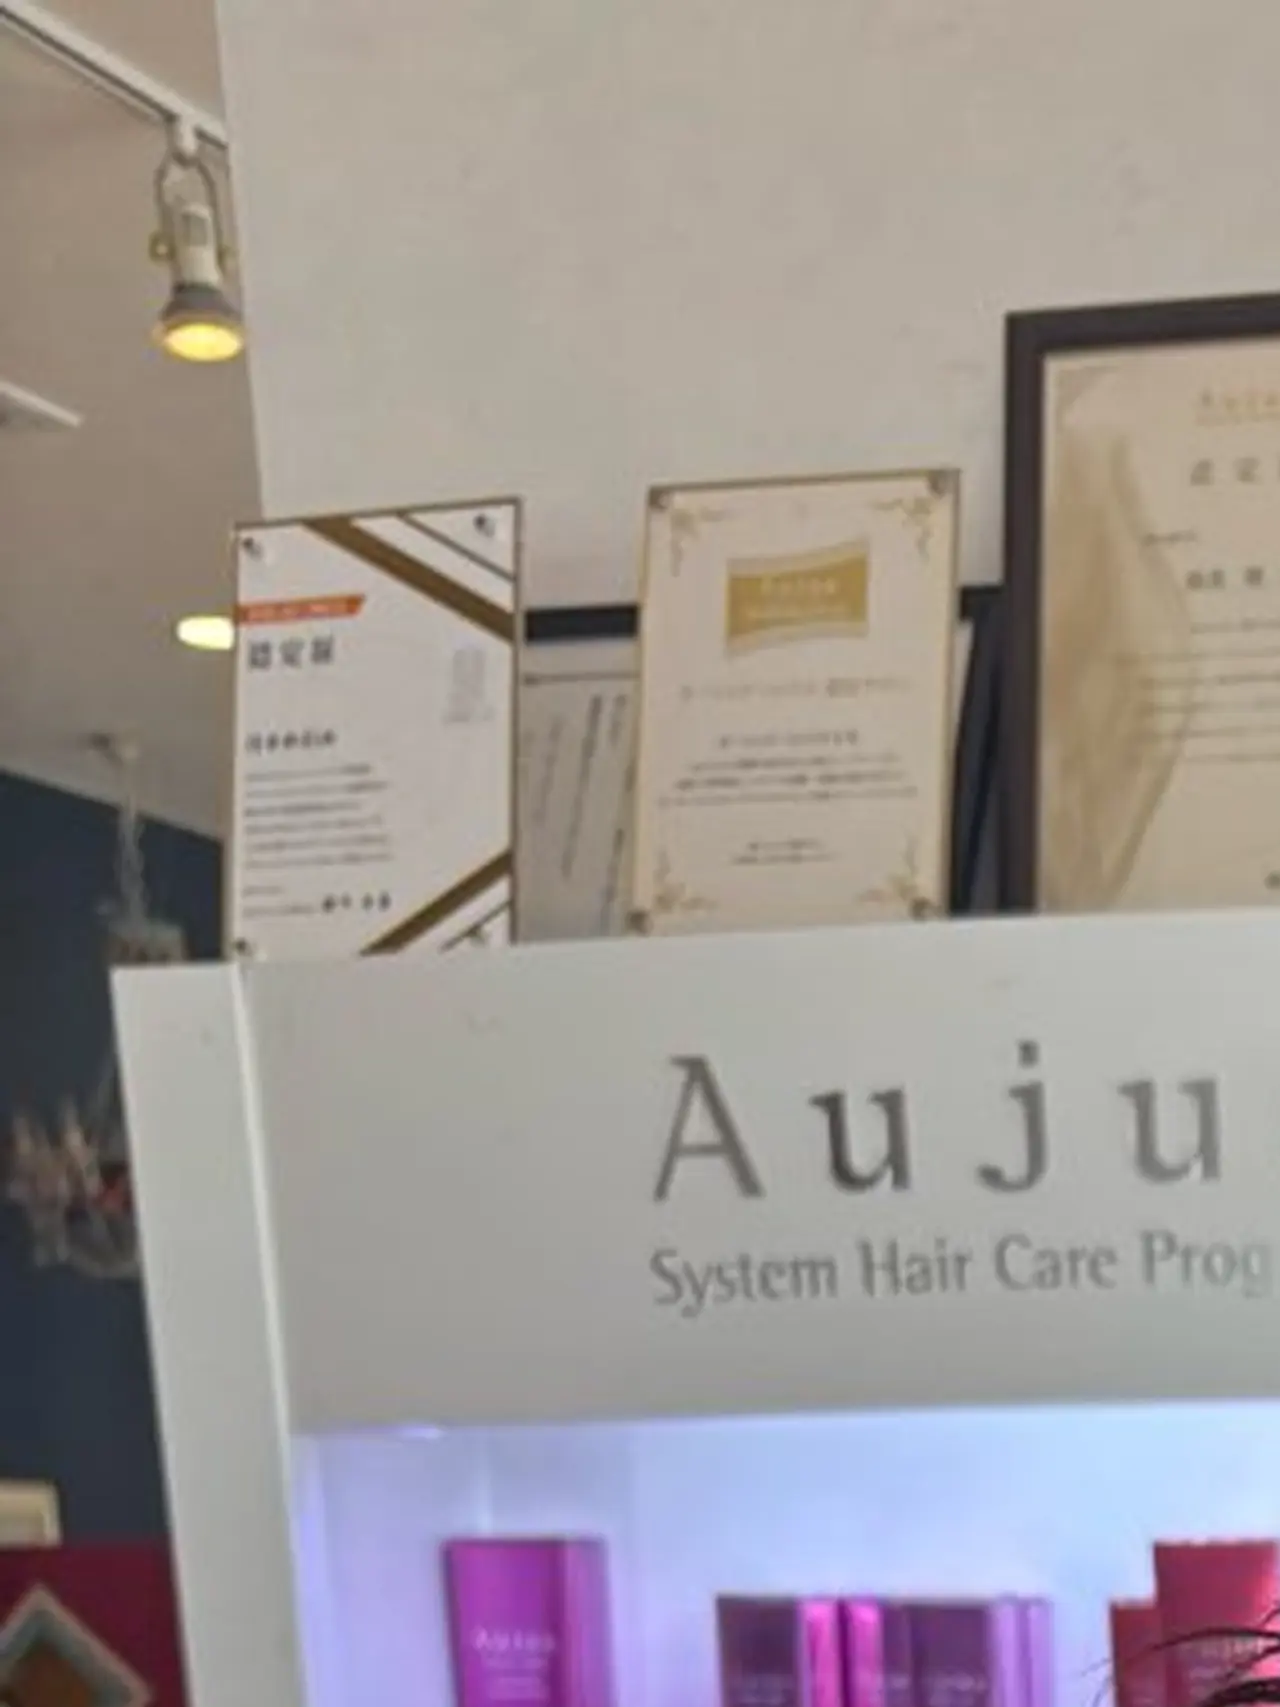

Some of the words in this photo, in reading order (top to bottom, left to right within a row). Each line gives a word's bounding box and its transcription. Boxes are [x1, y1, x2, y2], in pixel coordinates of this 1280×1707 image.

[650, 1247, 839, 1319] System
[853, 1235, 973, 1299] Hair
[994, 1231, 1119, 1291] Care
